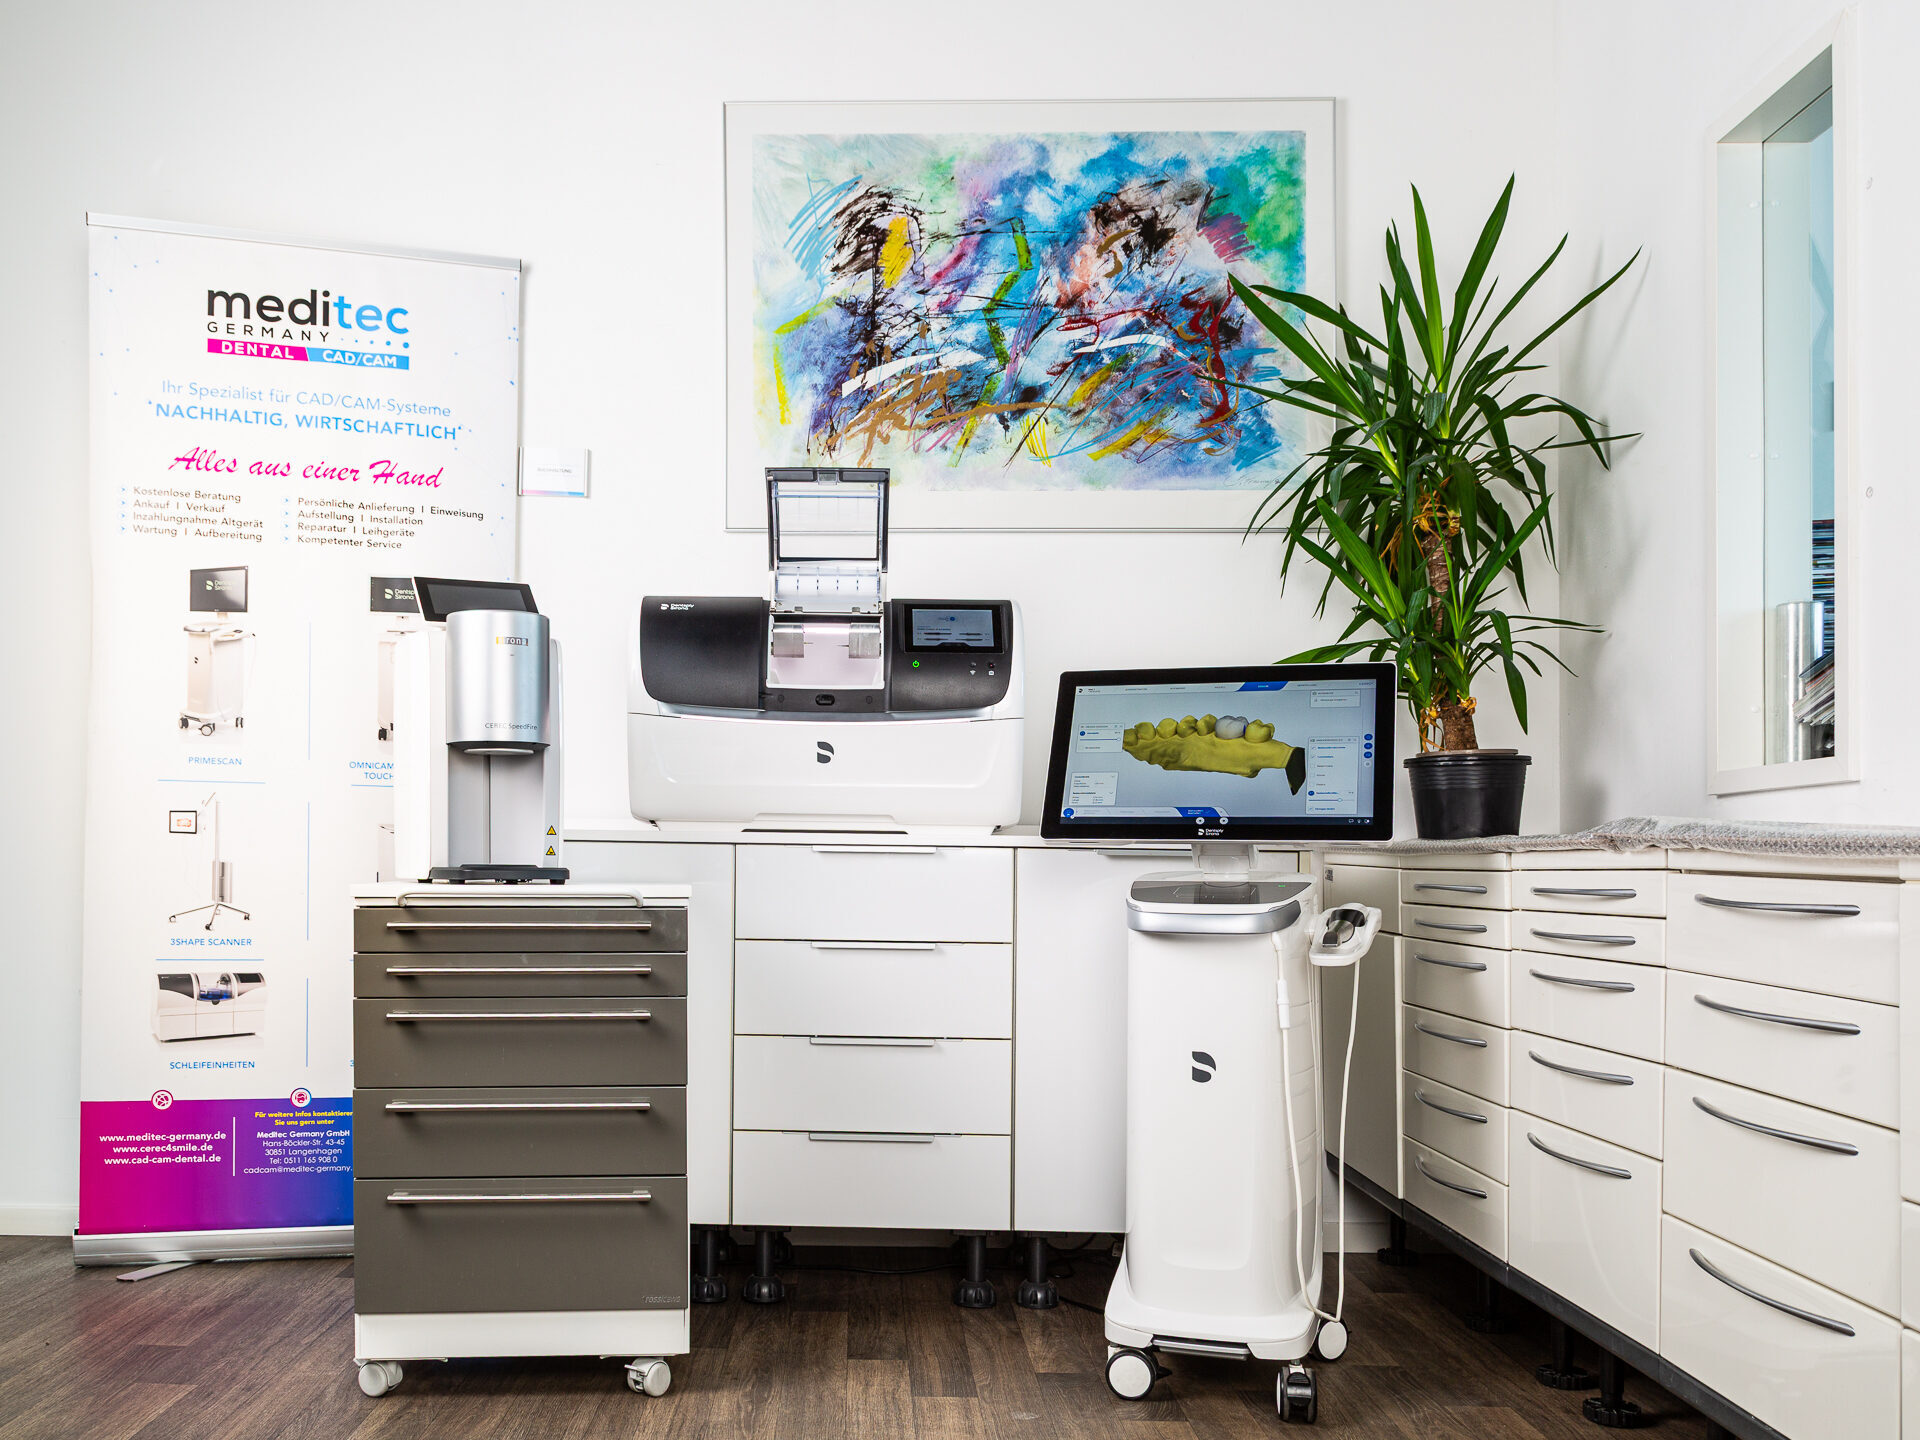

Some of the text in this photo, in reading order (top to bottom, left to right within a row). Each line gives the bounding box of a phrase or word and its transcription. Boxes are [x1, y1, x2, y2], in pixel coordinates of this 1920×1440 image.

[207, 289, 409, 334] meditec
[207, 322, 330, 342] GERMANY
[221, 340, 398, 368] DENTAL CAD/CAM
[162, 380, 451, 418] Ihr Spezialist für CAD/CAM-Systeme
[156, 402, 456, 440] NACHHALTIG, WIRTSCHAFTLICH
[168, 446, 444, 488] Alles aus einer Hand
[133, 486, 241, 504] Kostenlose Beratung
[133, 499, 170, 510] Ankauf
[186, 502, 226, 513] Verkauf
[298, 497, 354, 510] Persönliche
[358, 502, 414, 515] Anlieferung
[430, 506, 484, 522] Einweisung
[133, 512, 264, 529] Inzahlungnahme Altgerät
[298, 510, 354, 524] Aufstellung
[370, 515, 424, 526] Installation
[132, 524, 178, 538] Wartung
[194, 528, 262, 543] Aufbereitung
[298, 522, 346, 533] Reparatur
[362, 526, 415, 538] Leihgeräte
[298, 534, 402, 549] Kompetenter Service
[188, 756, 243, 766] PRIMESCAN
[350, 761, 394, 770] OMNICAM
[170, 938, 252, 946] 3SHAPE SCANNER
[170, 1060, 255, 1070] SCHLEIFEINHEITEN
[99, 1130, 226, 1142] www.meditec-germany.de
[112, 1143, 213, 1153] www.cerec4smile.de
[288, 1148, 342, 1156] Langenhagen
[104, 1154, 222, 1165] www.cad-cam-dental.de
